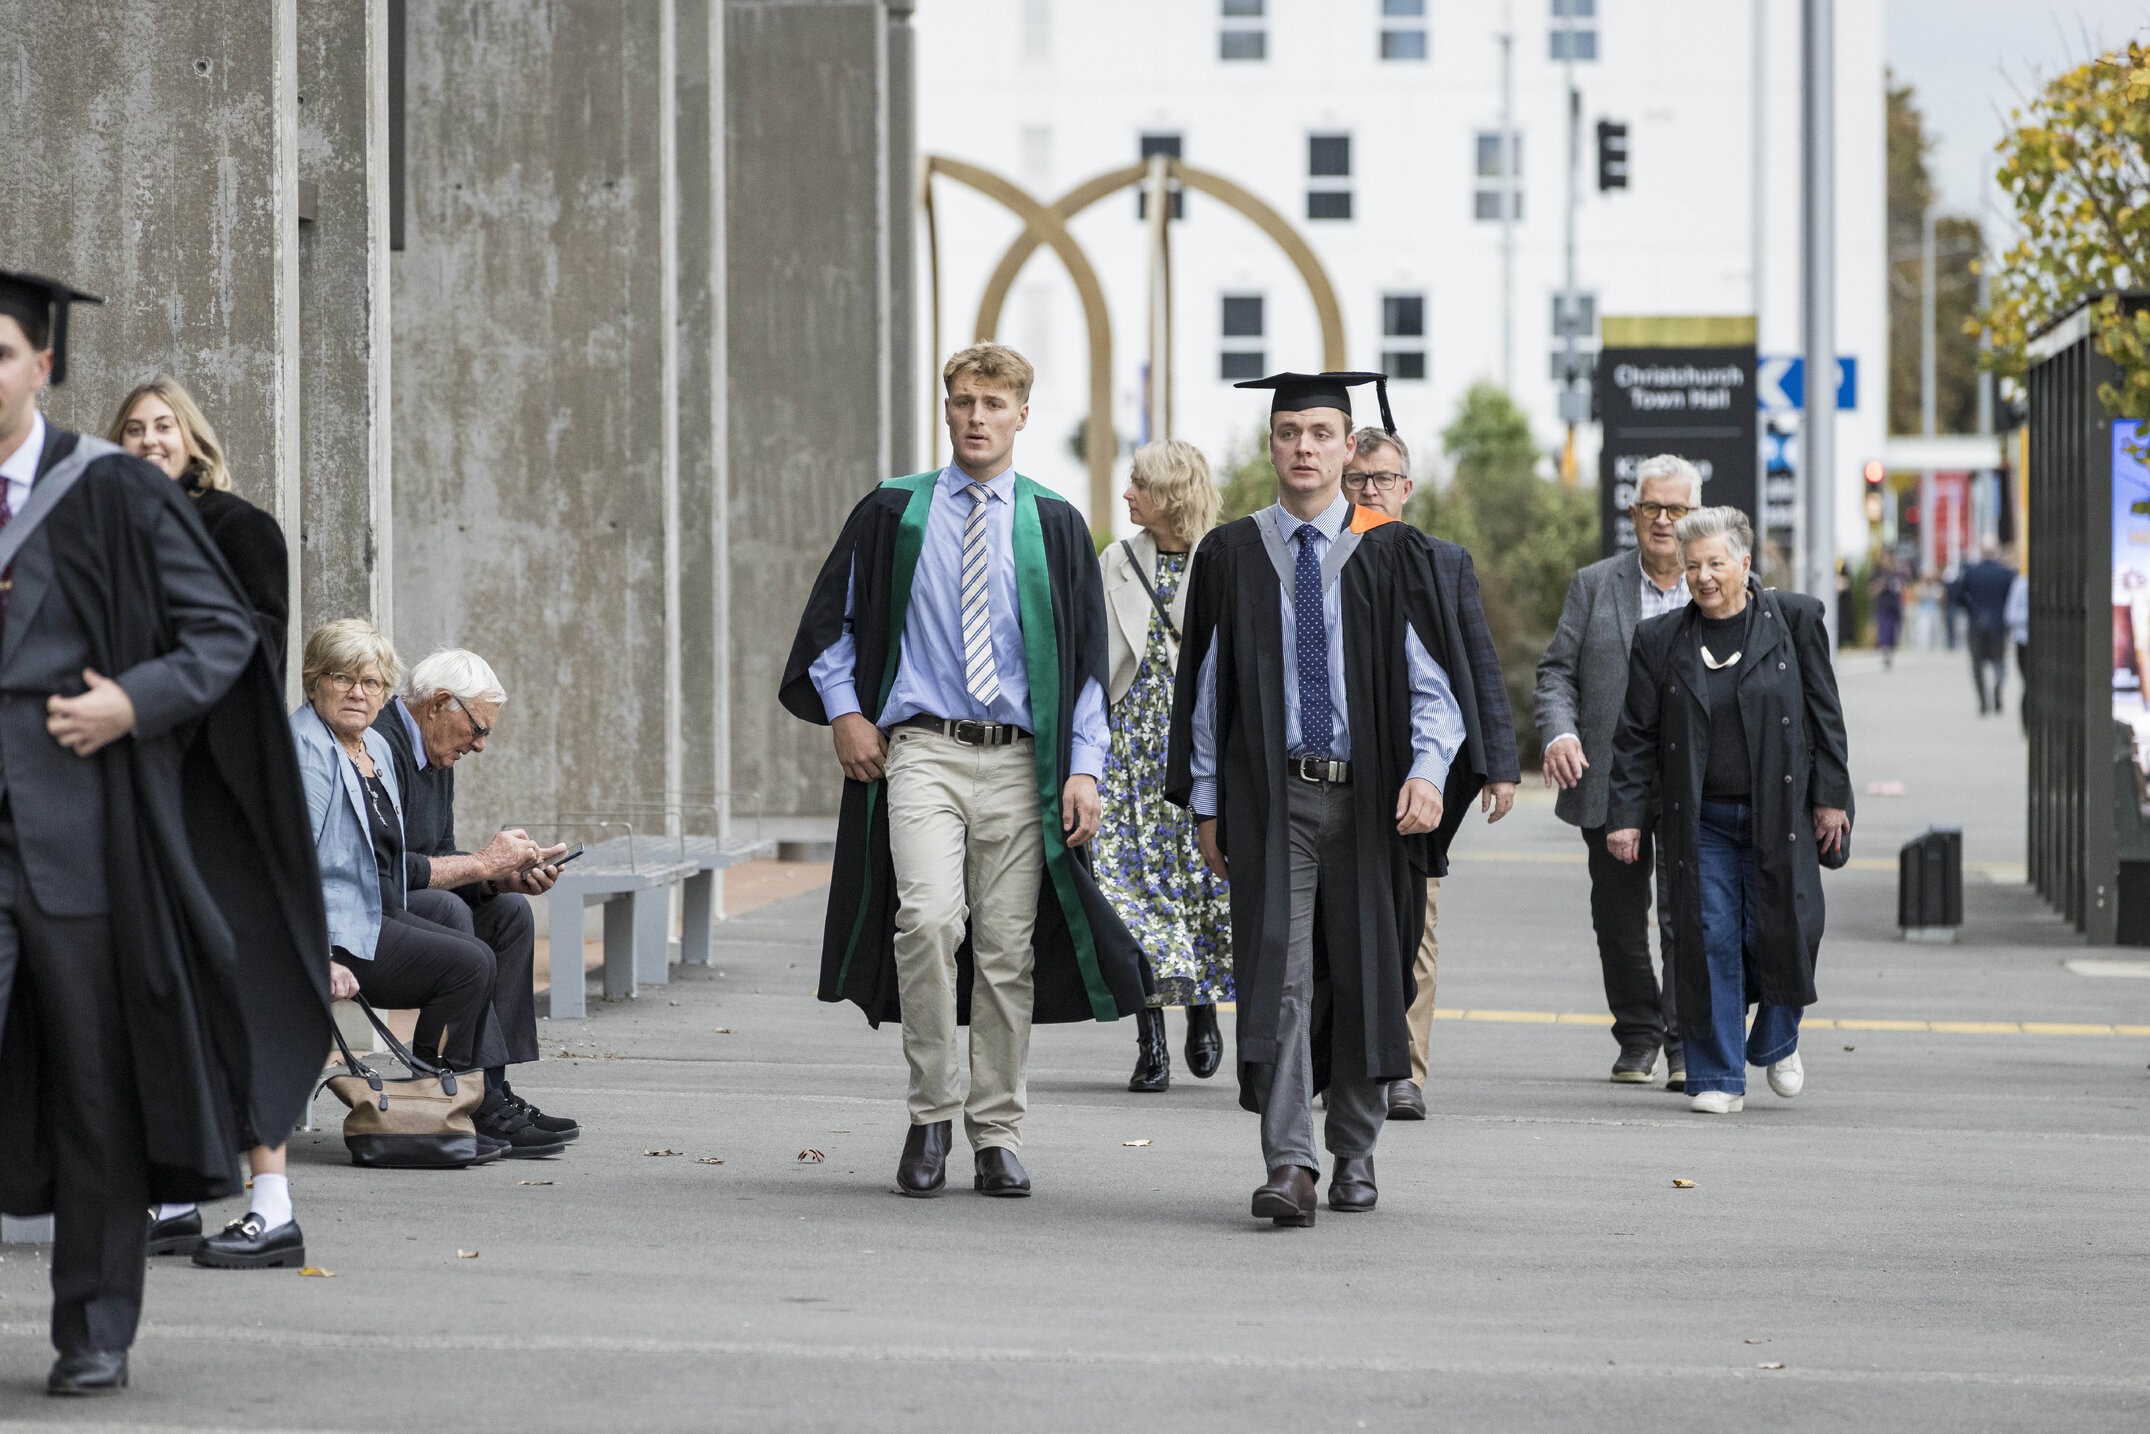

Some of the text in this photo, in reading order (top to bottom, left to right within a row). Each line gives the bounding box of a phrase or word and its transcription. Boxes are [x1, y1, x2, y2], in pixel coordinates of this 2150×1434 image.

[1614, 364, 1744, 387] Christchurch
[1629, 388, 1730, 410] Town Hall
